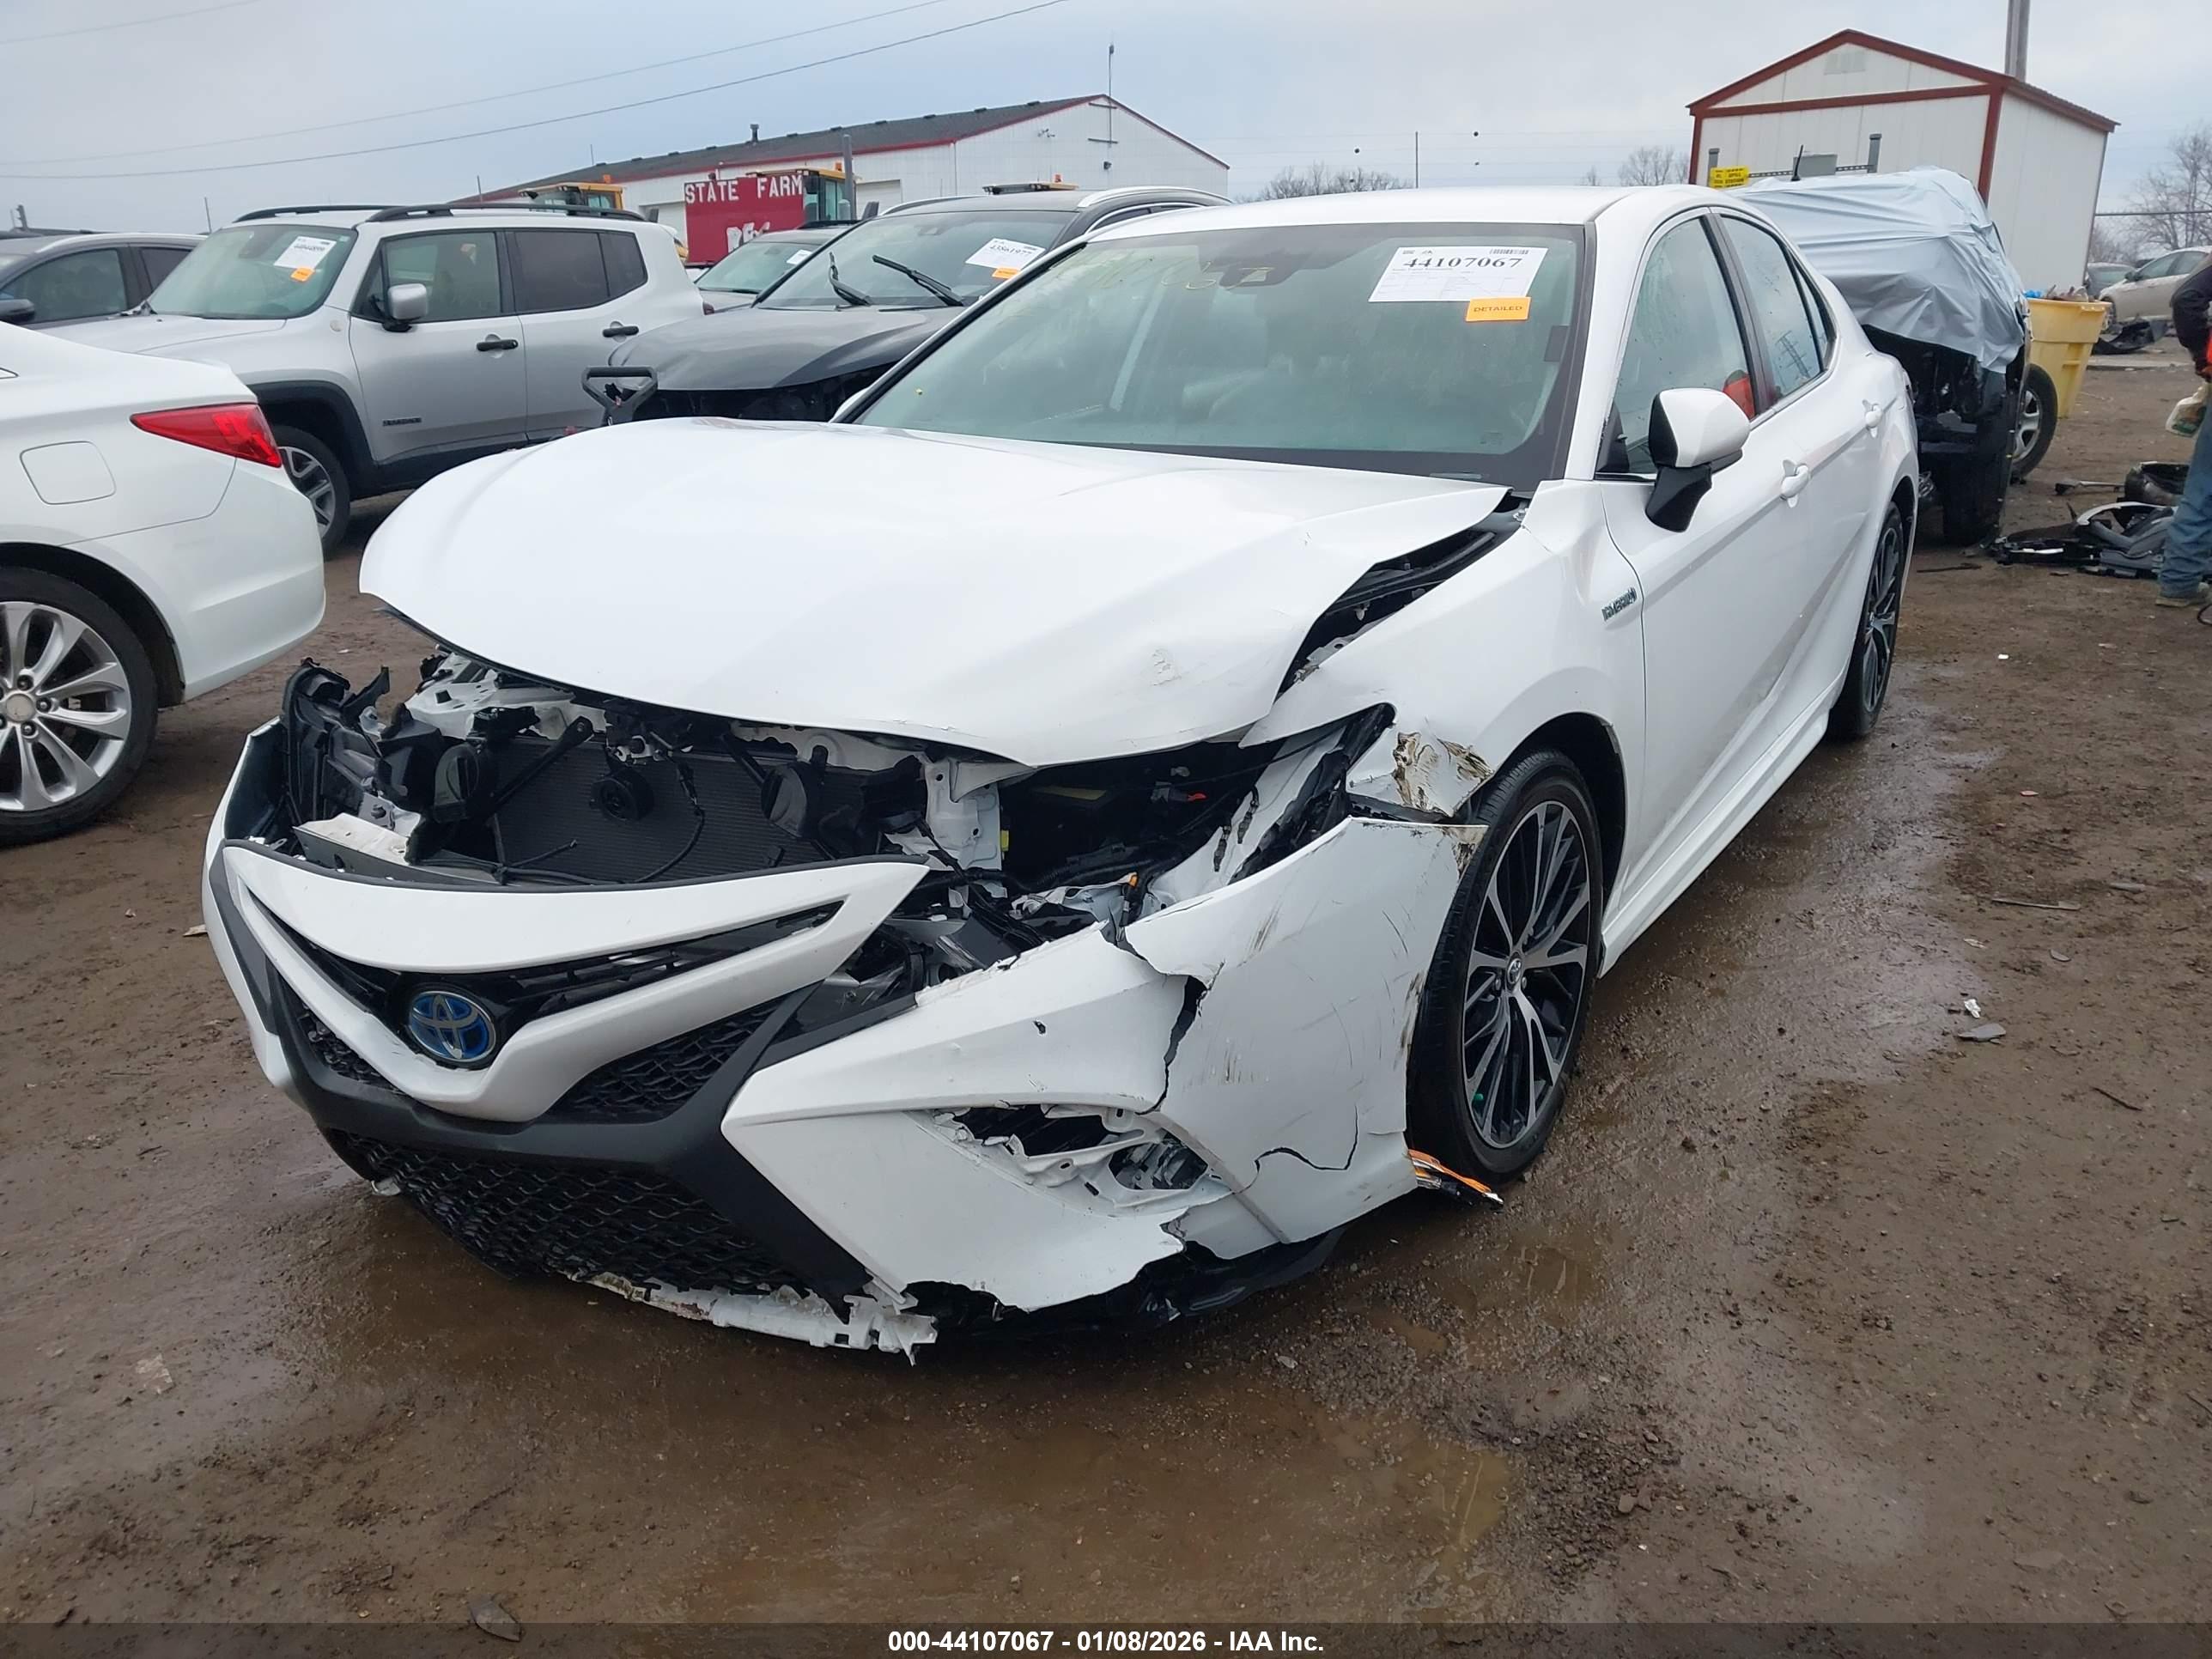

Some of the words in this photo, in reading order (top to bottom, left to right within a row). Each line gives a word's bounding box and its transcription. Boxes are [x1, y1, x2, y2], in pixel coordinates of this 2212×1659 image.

[685, 180, 739, 204] STATE
[757, 174, 803, 198] FARM
[1403, 257, 1523, 268] 44107067
[1473, 305, 1523, 313] DETAILED
